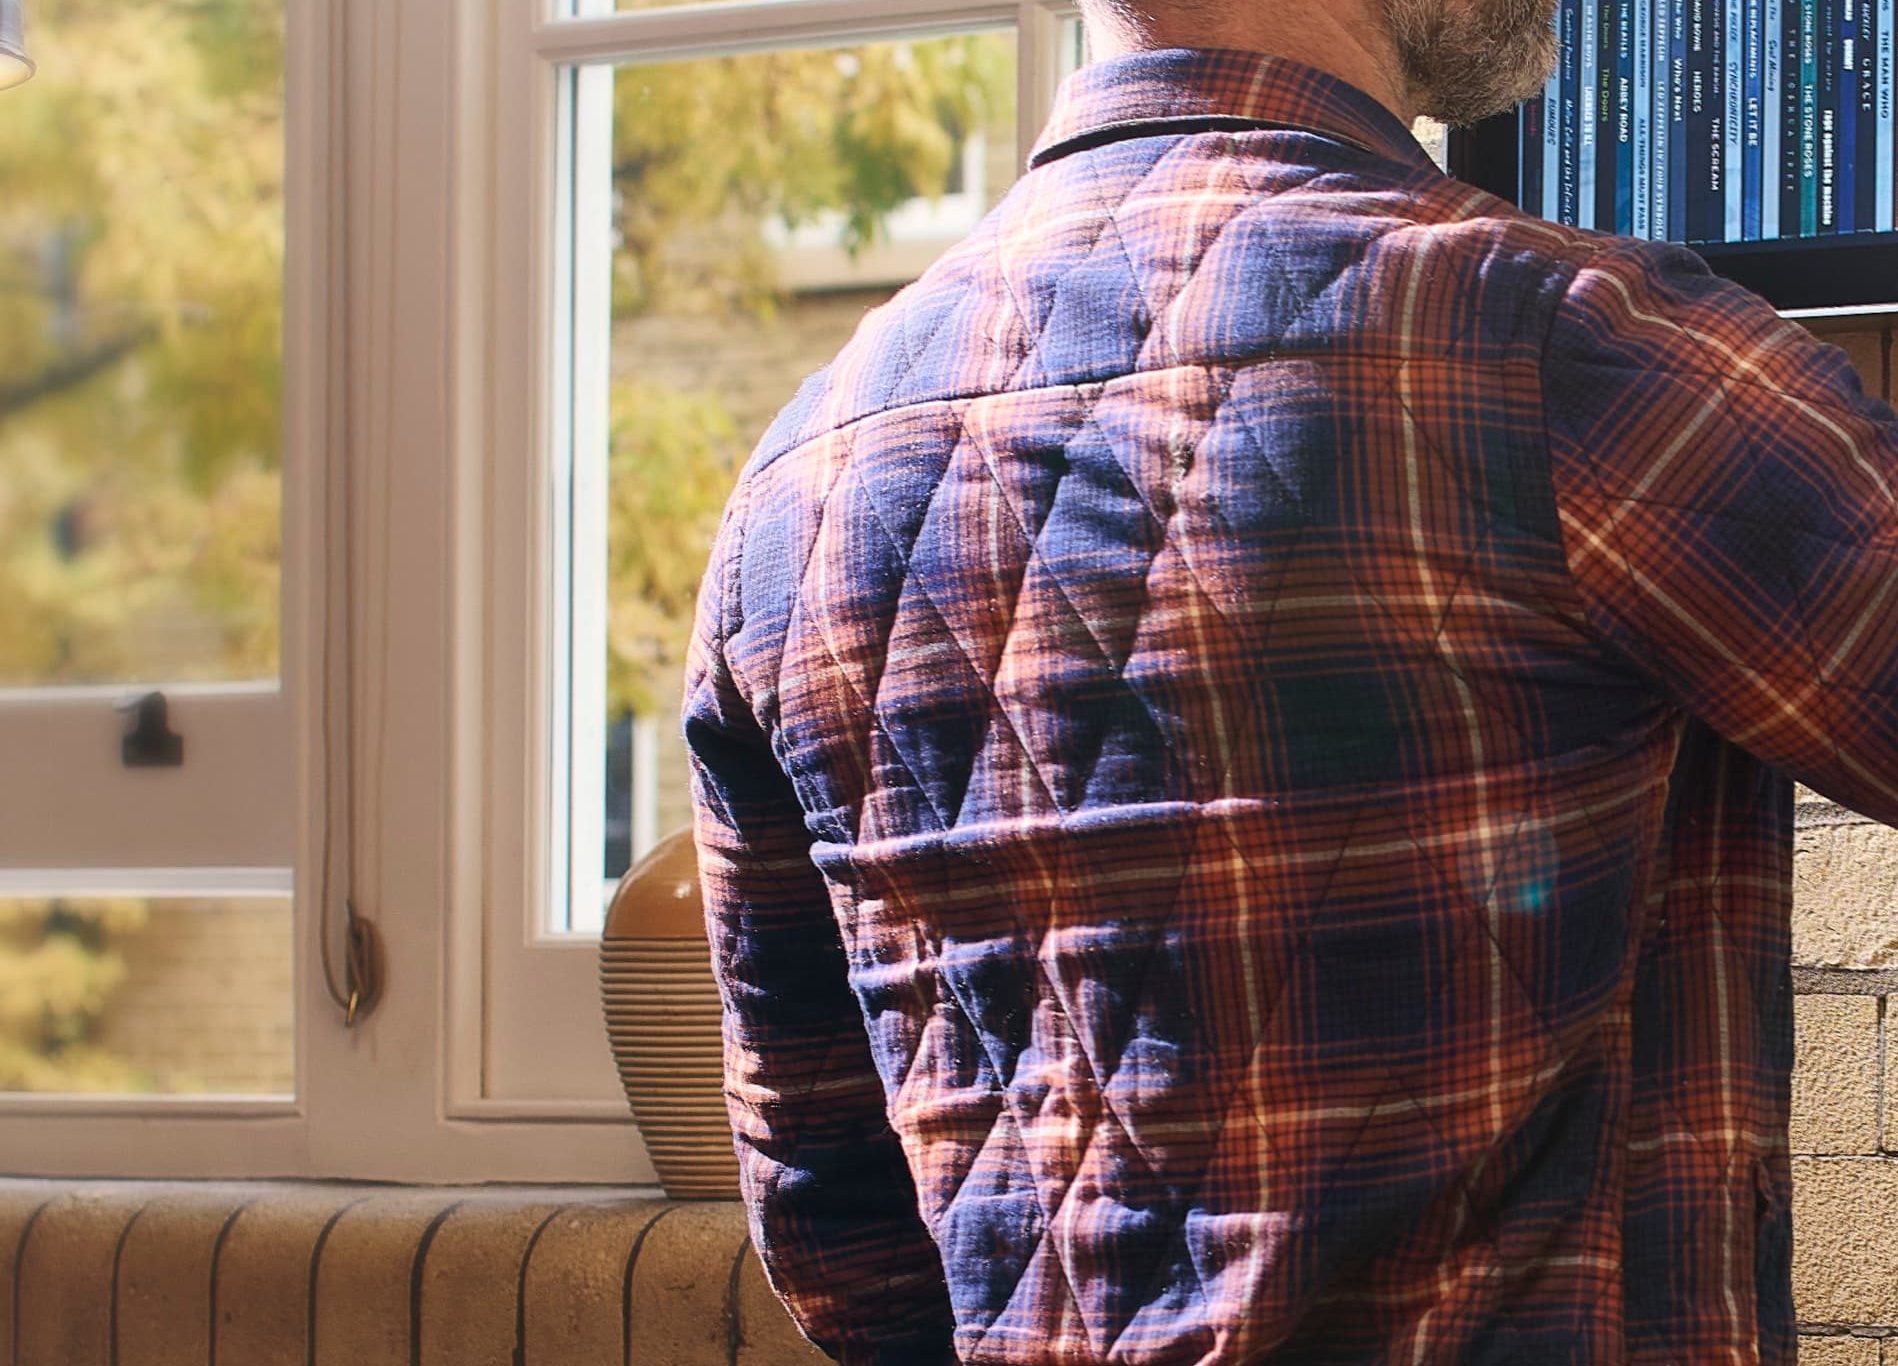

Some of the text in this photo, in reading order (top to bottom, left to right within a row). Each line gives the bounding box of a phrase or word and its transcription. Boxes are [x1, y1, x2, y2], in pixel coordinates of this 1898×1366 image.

[1675, 17, 1683, 39] Who
[1693, 23, 1702, 52] BOWIE
[1602, 68, 1611, 122] The Doors
[1674, 58, 1683, 122] Who's Next
[1693, 71, 1702, 113] HEROES
[1861, 58, 1871, 112] GRACE
[1880, 30, 1890, 119] THE MAN WHO
[1620, 77, 1629, 143] ABBEY ROAD
[1730, 62, 1739, 145] SYNCHRONICITY
[1748, 97, 1758, 117] LET
[1711, 118, 1720, 191] THE SCREAM
[1748, 132, 1758, 147] BE
[1804, 84, 1814, 178] THE STONE ROSES
